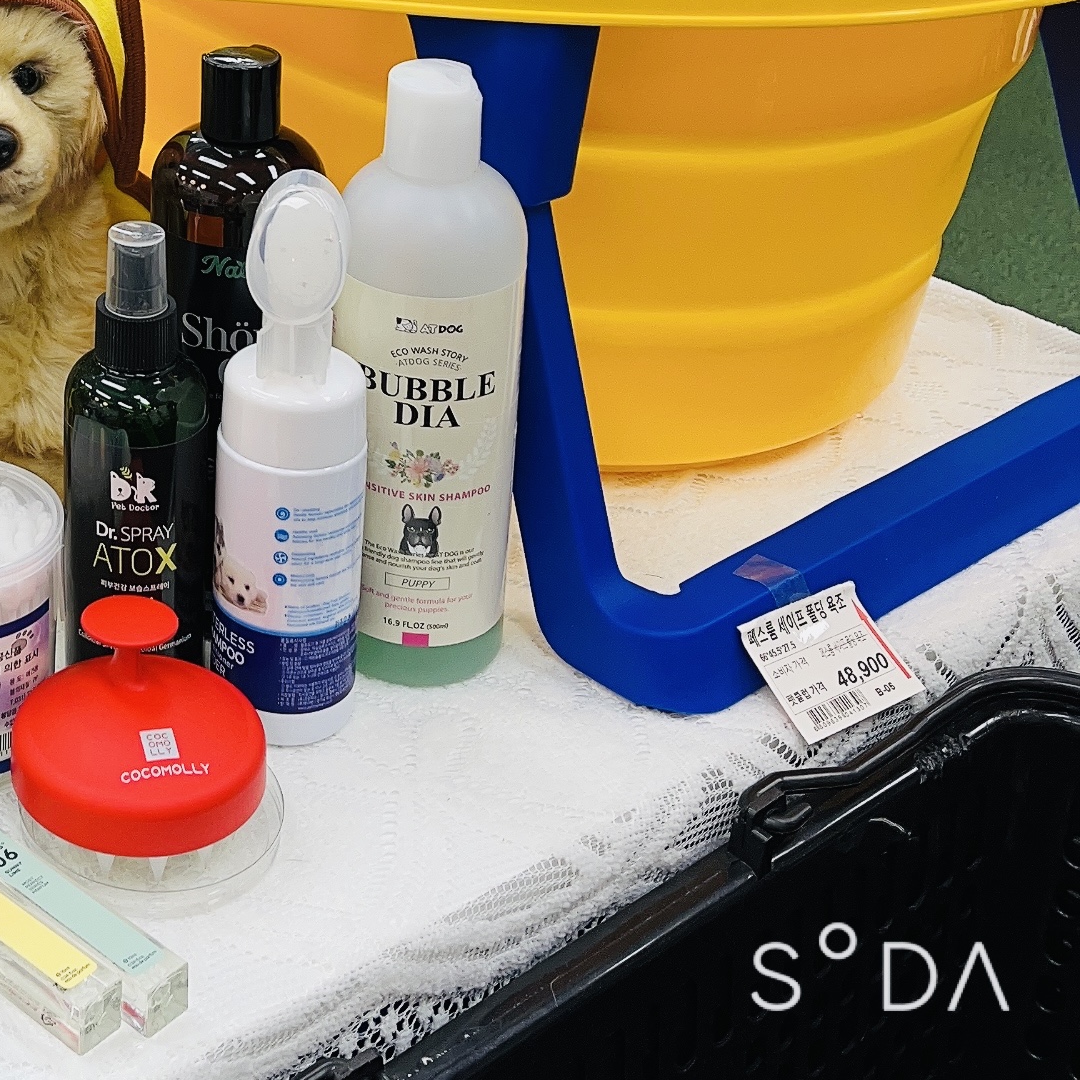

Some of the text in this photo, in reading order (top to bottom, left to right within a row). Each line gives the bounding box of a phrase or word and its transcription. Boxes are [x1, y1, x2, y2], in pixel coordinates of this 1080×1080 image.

[181, 312, 258, 353] Shö
[390, 346, 469, 363] ECO WASH STORY
[360, 362, 496, 402] BUBBLE
[394, 400, 461, 429] DIA
[409, 492, 436, 502] SKIN
[439, 484, 491, 502] SHAMPOO
[111, 501, 160, 512] Pet Doctor
[95, 520, 175, 542] Dr. SPRAY
[92, 542, 178, 576] ATOX
[387, 553, 399, 562] dog
[400, 556, 430, 565] shampoo
[401, 578, 436, 588] PUPPY
[375, 591, 390, 599] and
[416, 597, 446, 605] formula
[383, 616, 400, 626] 16.9
[777, 609, 807, 635] 세이프
[806, 600, 827, 622] 폴딩
[826, 593, 847, 613] 욕조
[3, 659, 22, 673] 의한
[24, 647, 40, 664] 표시
[837, 652, 889, 688] 48,900
[809, 681, 828, 696] 가격
[120, 763, 210, 784] COCOMOLLY
